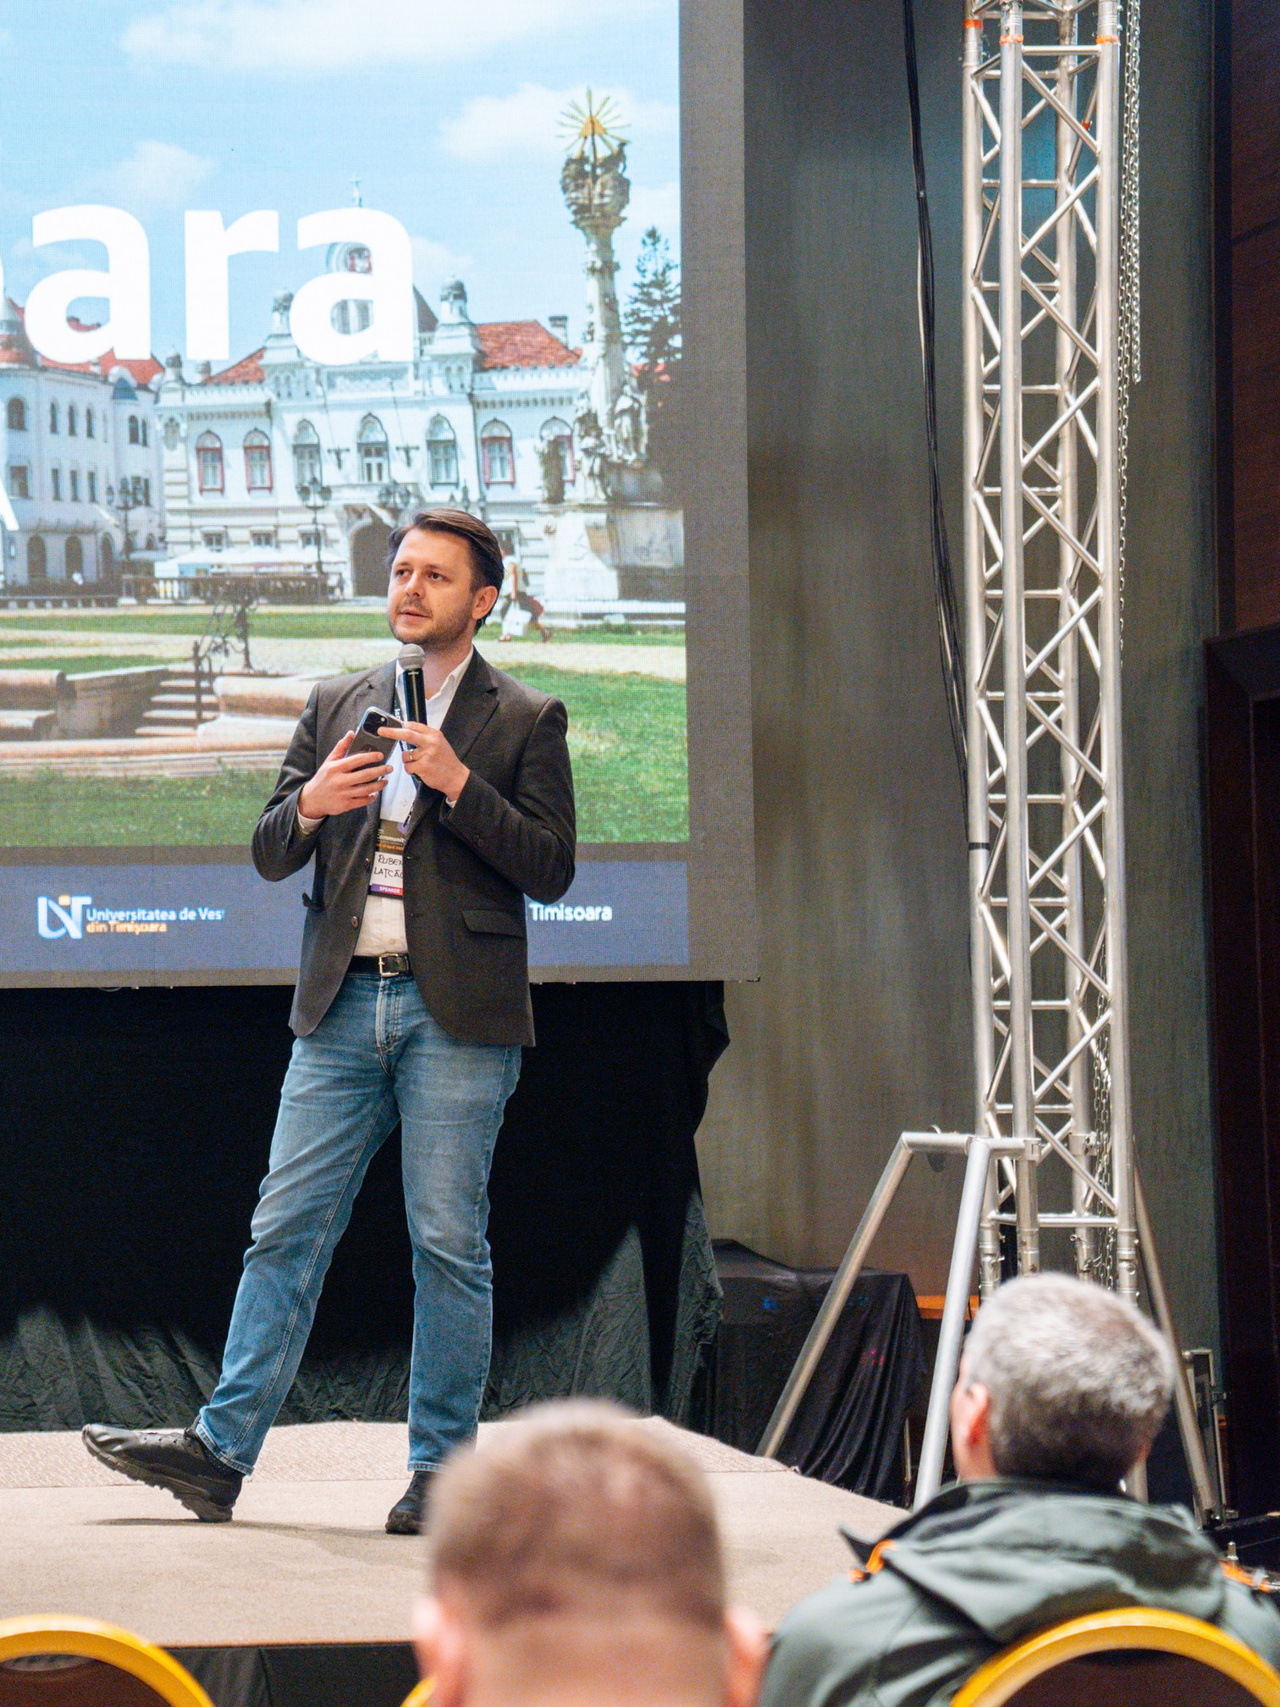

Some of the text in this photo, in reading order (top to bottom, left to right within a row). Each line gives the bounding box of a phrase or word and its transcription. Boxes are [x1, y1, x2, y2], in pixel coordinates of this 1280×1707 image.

[86, 907, 177, 922] Universitatea
[179, 907, 197, 921] de
[86, 919, 108, 933] din
